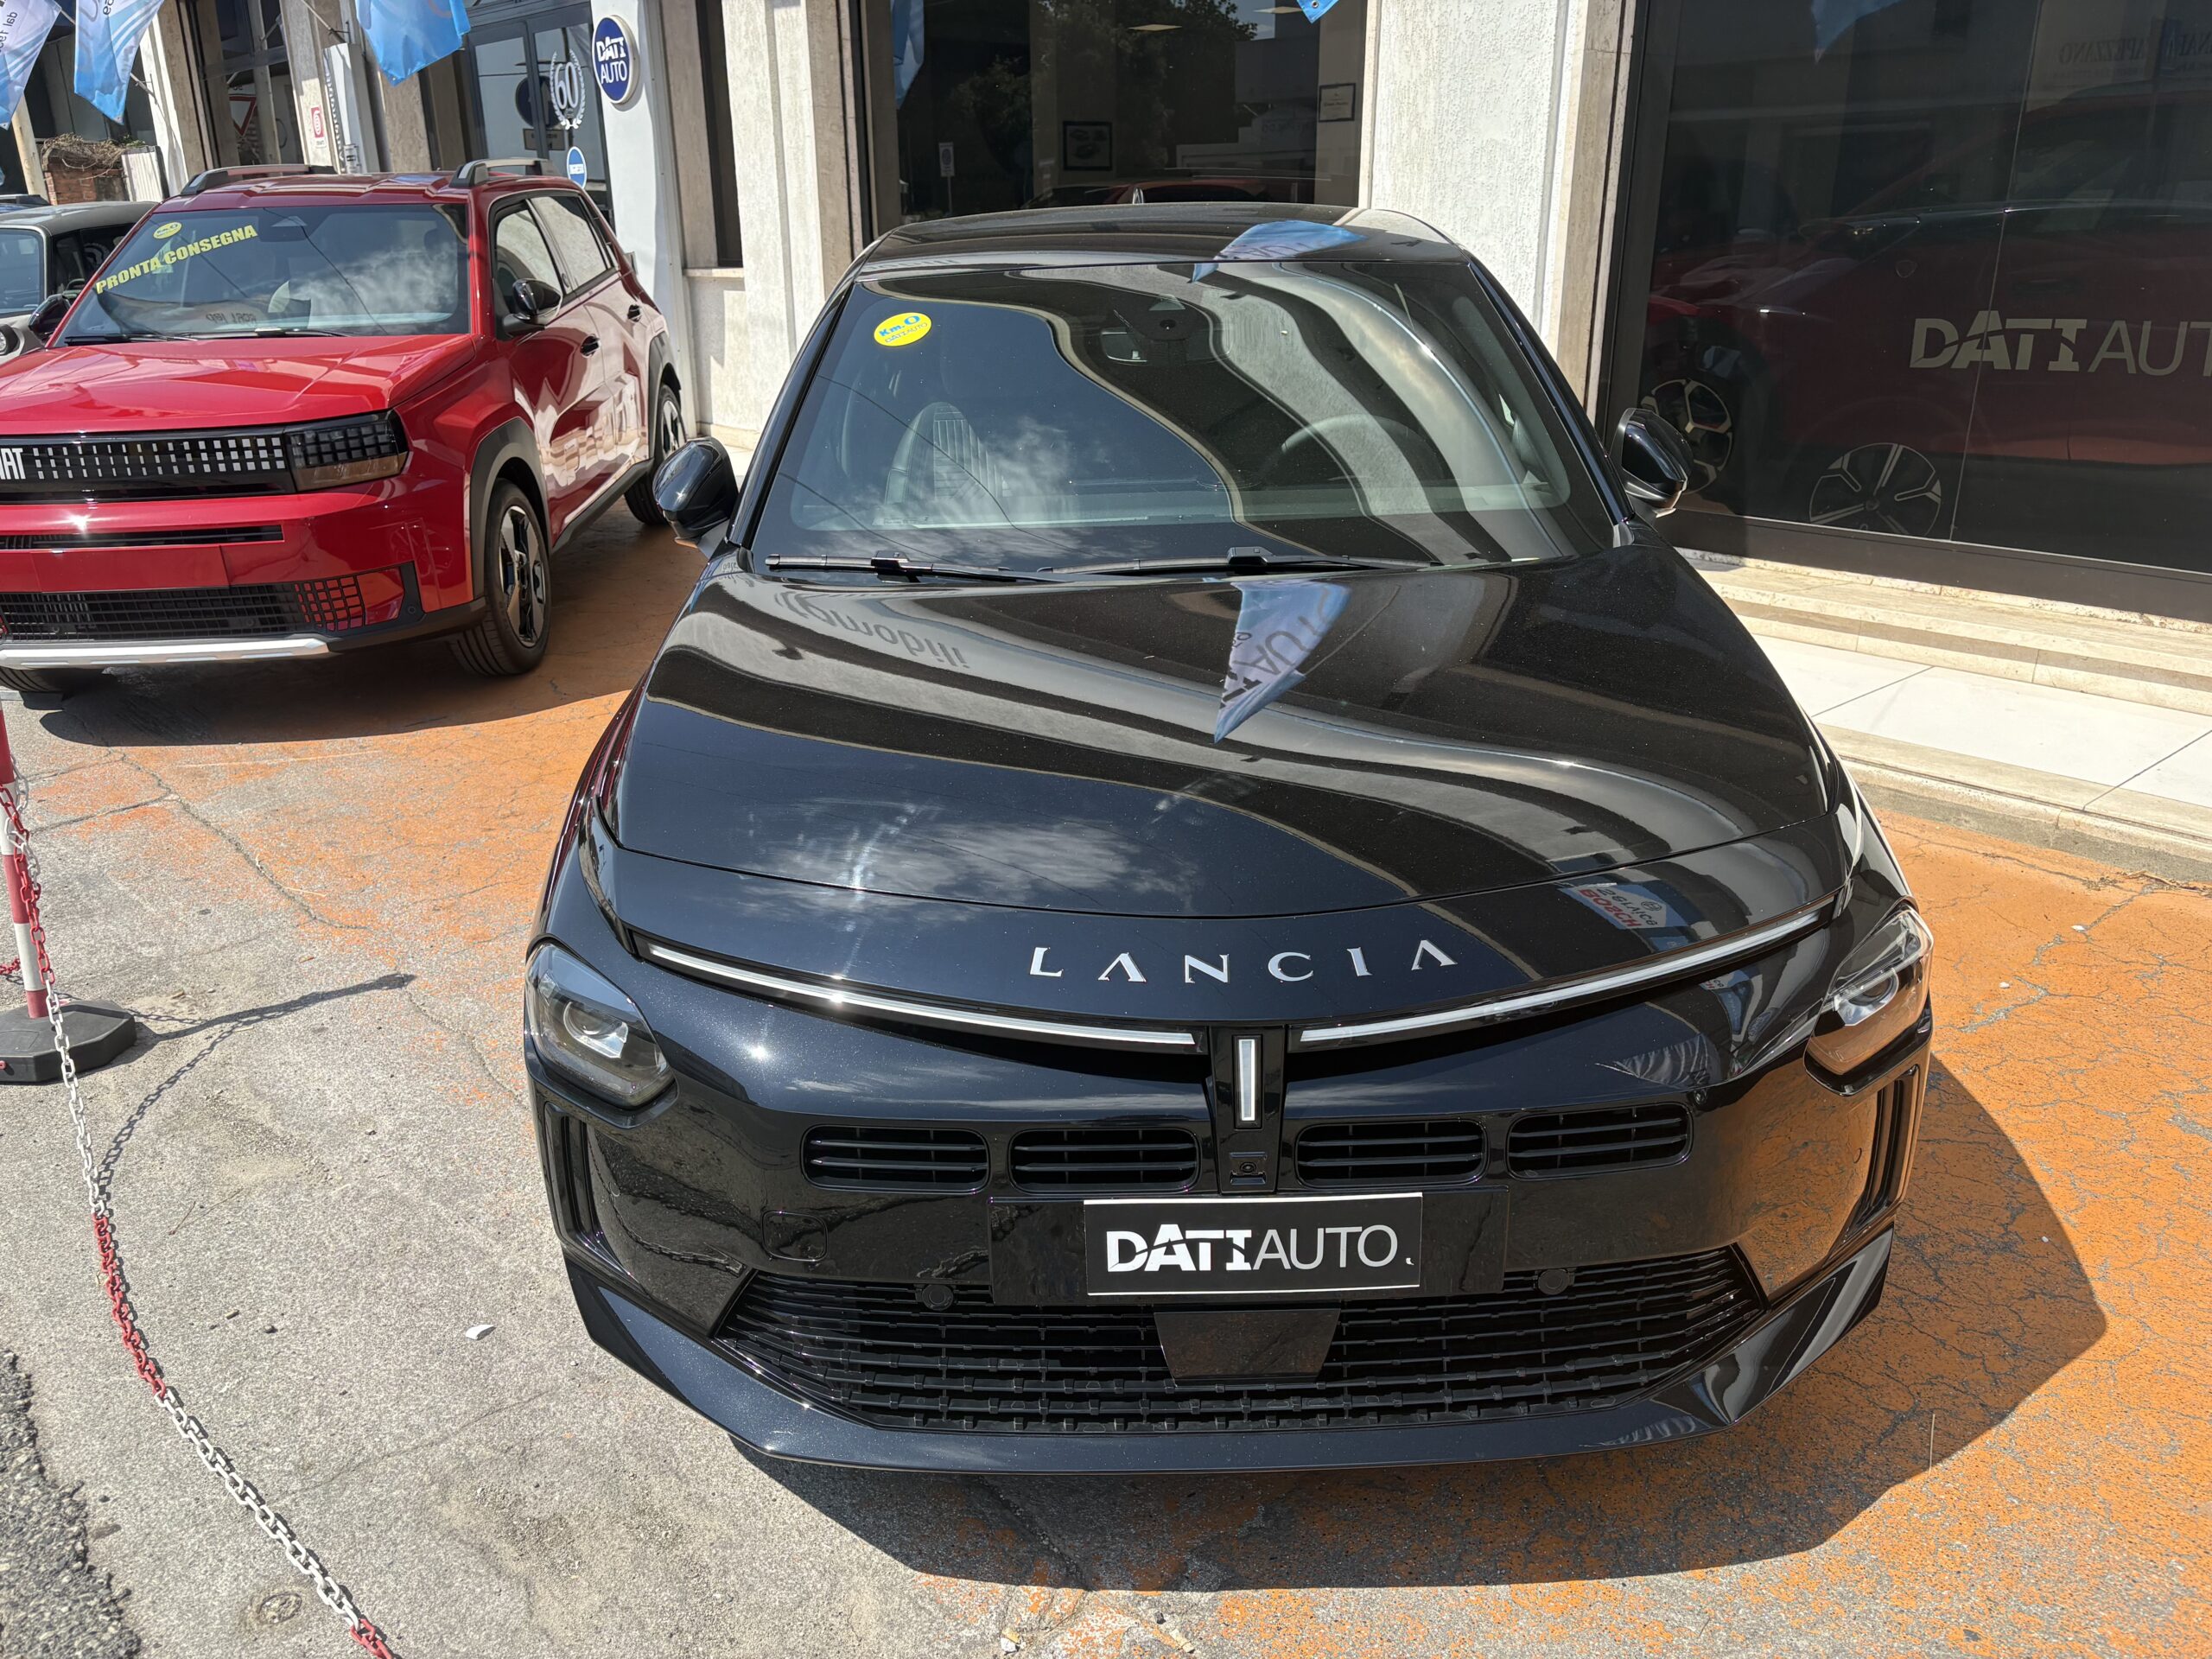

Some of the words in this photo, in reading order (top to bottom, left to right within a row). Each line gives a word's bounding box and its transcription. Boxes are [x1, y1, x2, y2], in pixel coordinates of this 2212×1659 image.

[596, 36, 626, 62] DATI
[554, 61, 579, 110] 60
[601, 60, 627, 85] AUTO
[95, 257, 165, 296] PRONTA
[164, 224, 258, 266] CONSEGNA
[1909, 309, 2212, 378] DATIAUT
[0, 448, 26, 480] AT
[1029, 939, 1458, 983] LANCIA
